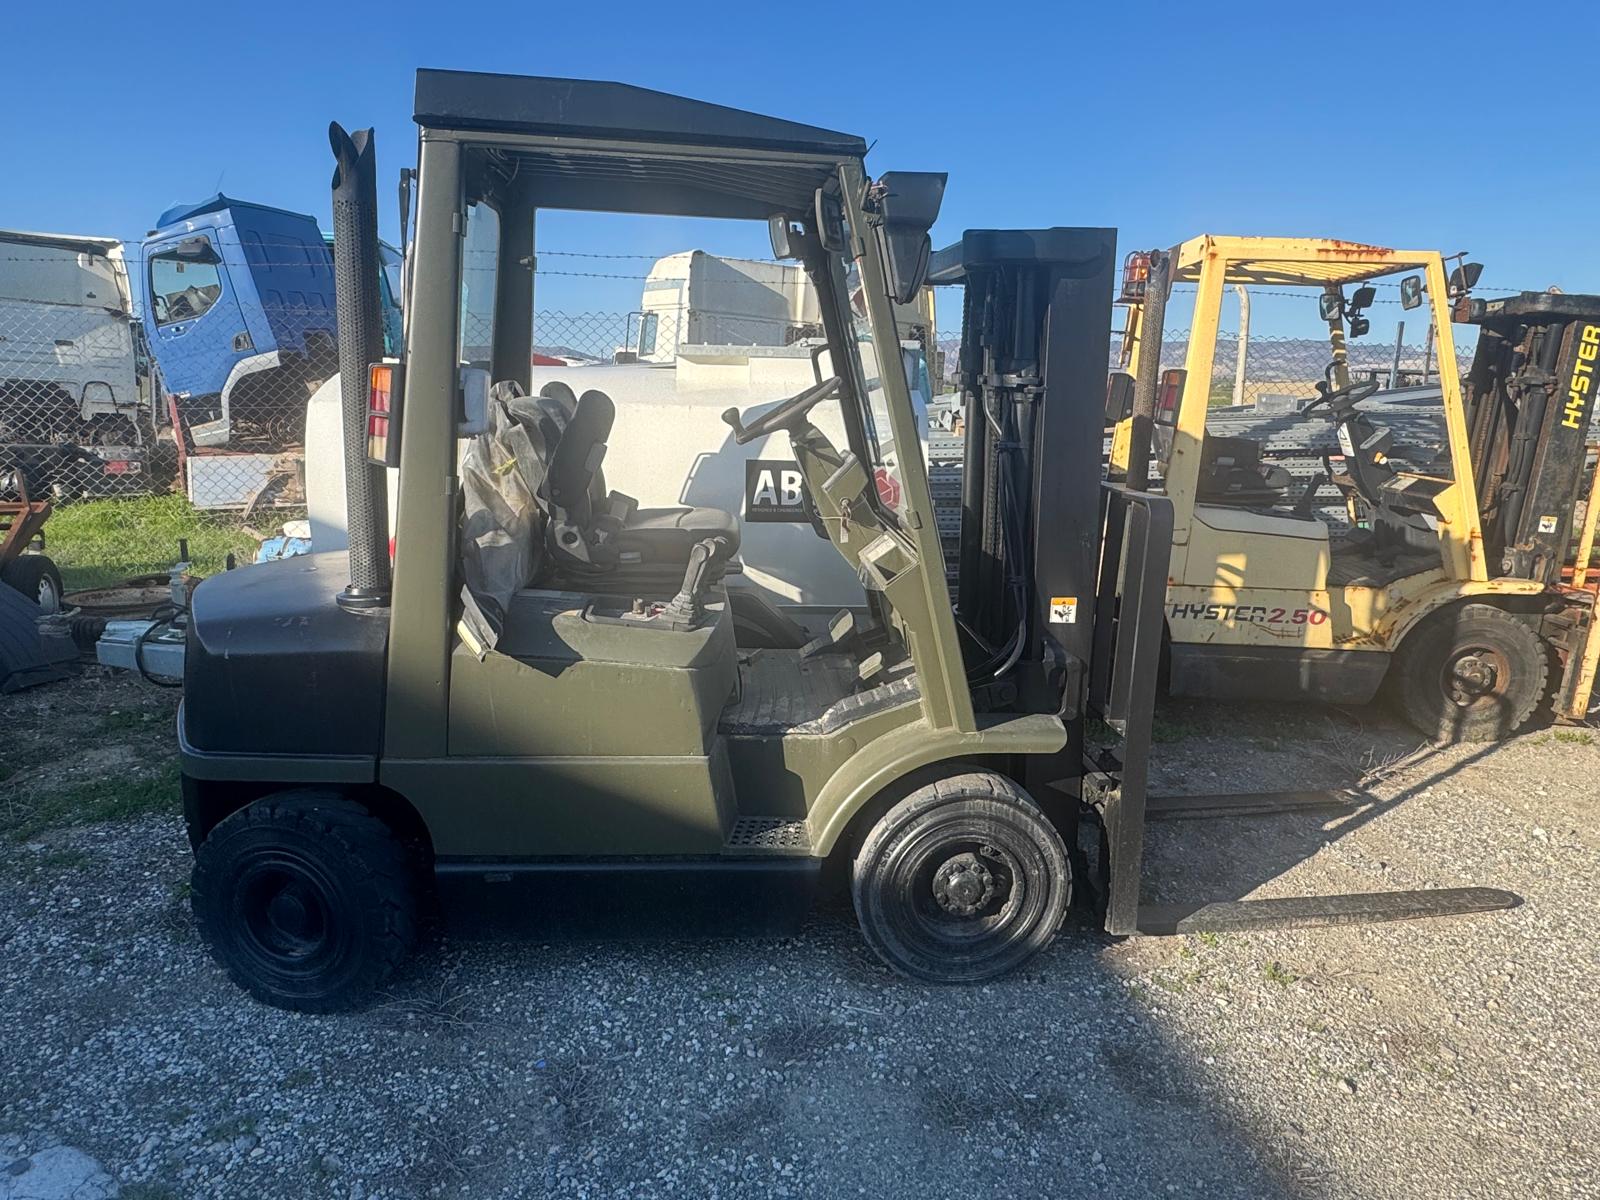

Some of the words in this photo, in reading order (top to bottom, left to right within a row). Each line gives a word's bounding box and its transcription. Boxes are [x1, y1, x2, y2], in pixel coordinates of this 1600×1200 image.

[1561, 325, 1600, 429] HYSTER
[752, 470, 805, 506] AB
[1171, 603, 1267, 623] HYSTER
[1267, 608, 1328, 626] 2.50
